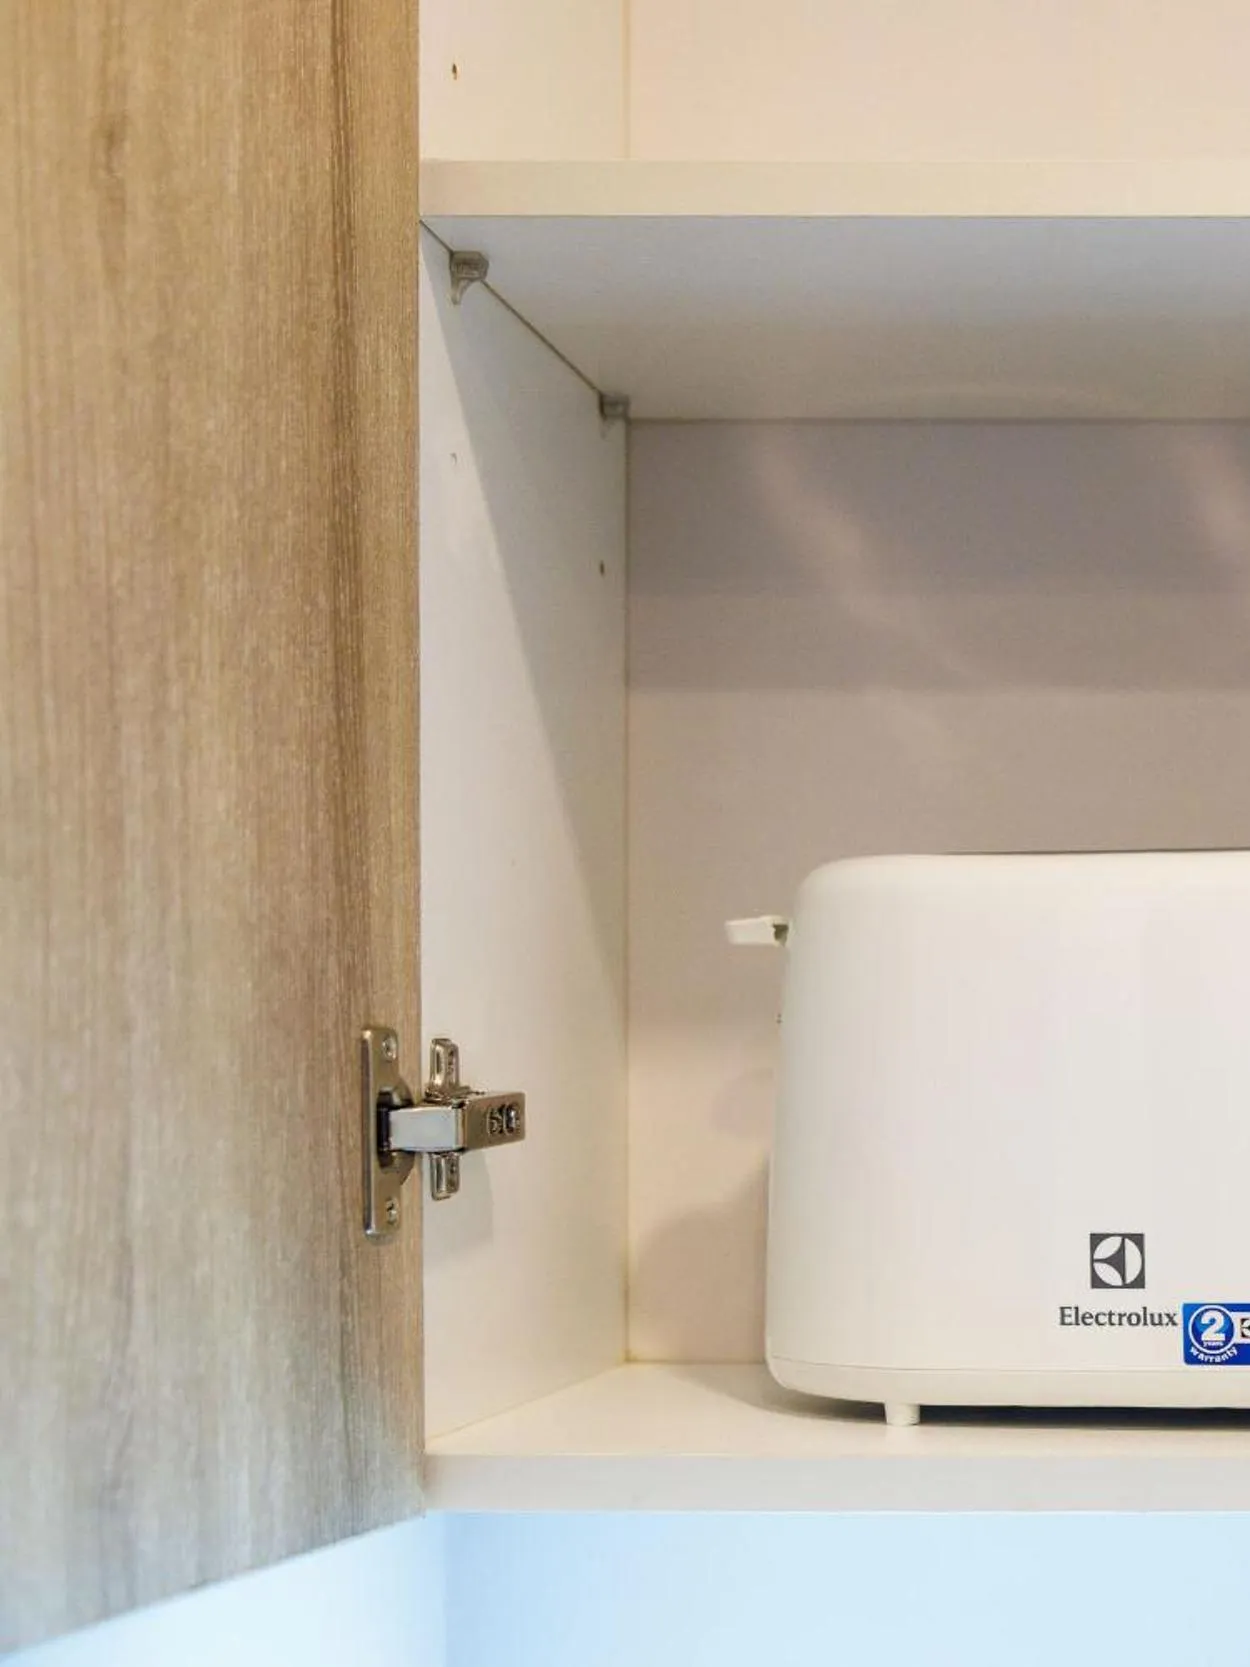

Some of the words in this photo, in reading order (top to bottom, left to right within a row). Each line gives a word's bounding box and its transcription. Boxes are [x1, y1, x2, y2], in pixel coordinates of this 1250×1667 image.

[1059, 1306, 1179, 1327] Electrolux
[1201, 1310, 1226, 1341] 2
[1190, 1346, 1238, 1363] warranty
